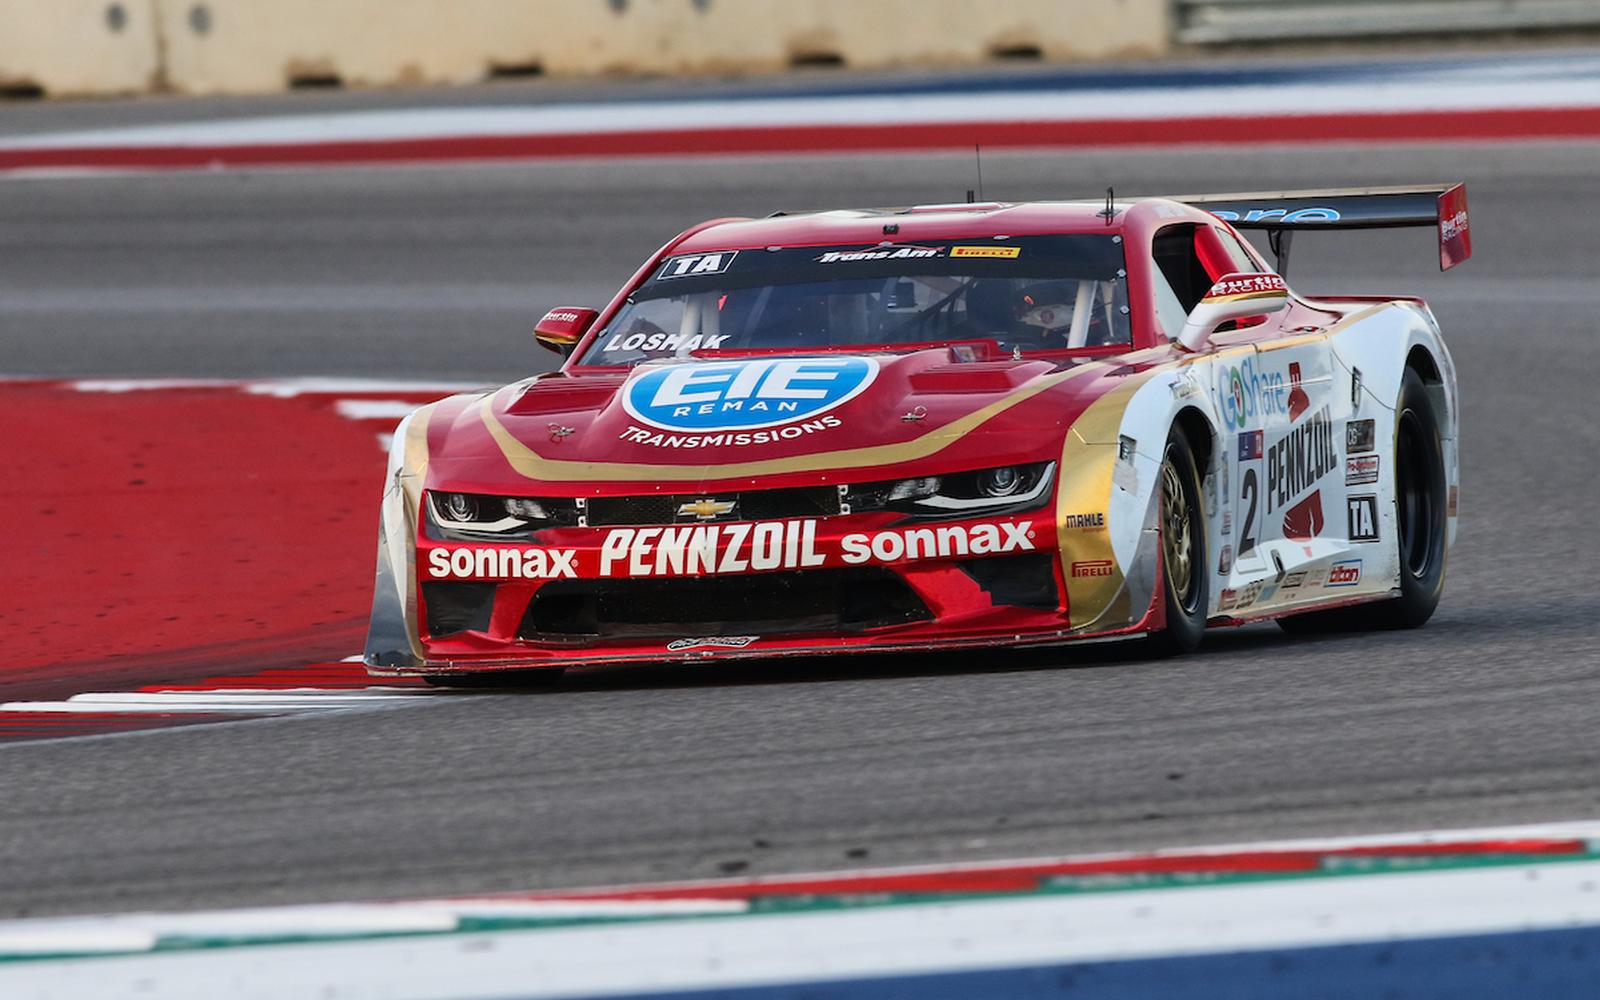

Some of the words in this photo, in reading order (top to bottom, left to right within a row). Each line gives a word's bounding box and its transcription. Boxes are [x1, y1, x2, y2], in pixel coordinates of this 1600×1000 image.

[674, 254, 722, 275] TA
[819, 251, 885, 263] Trans
[888, 248, 937, 259] Am
[603, 333, 732, 352] LOSHAK
[650, 360, 849, 407] EIE
[672, 401, 799, 417] REMAN
[618, 415, 843, 449] TRANSMISSIONS
[1267, 404, 1338, 515] PENNZOIL
[1066, 513, 1104, 528] MAHLE
[1238, 468, 1258, 556] 2
[1350, 500, 1374, 537] TA
[599, 520, 827, 577] PENNZOIL
[841, 521, 1034, 564] sonnax
[428, 547, 579, 579] sonnax
[1071, 560, 1113, 578] PIRELLI
